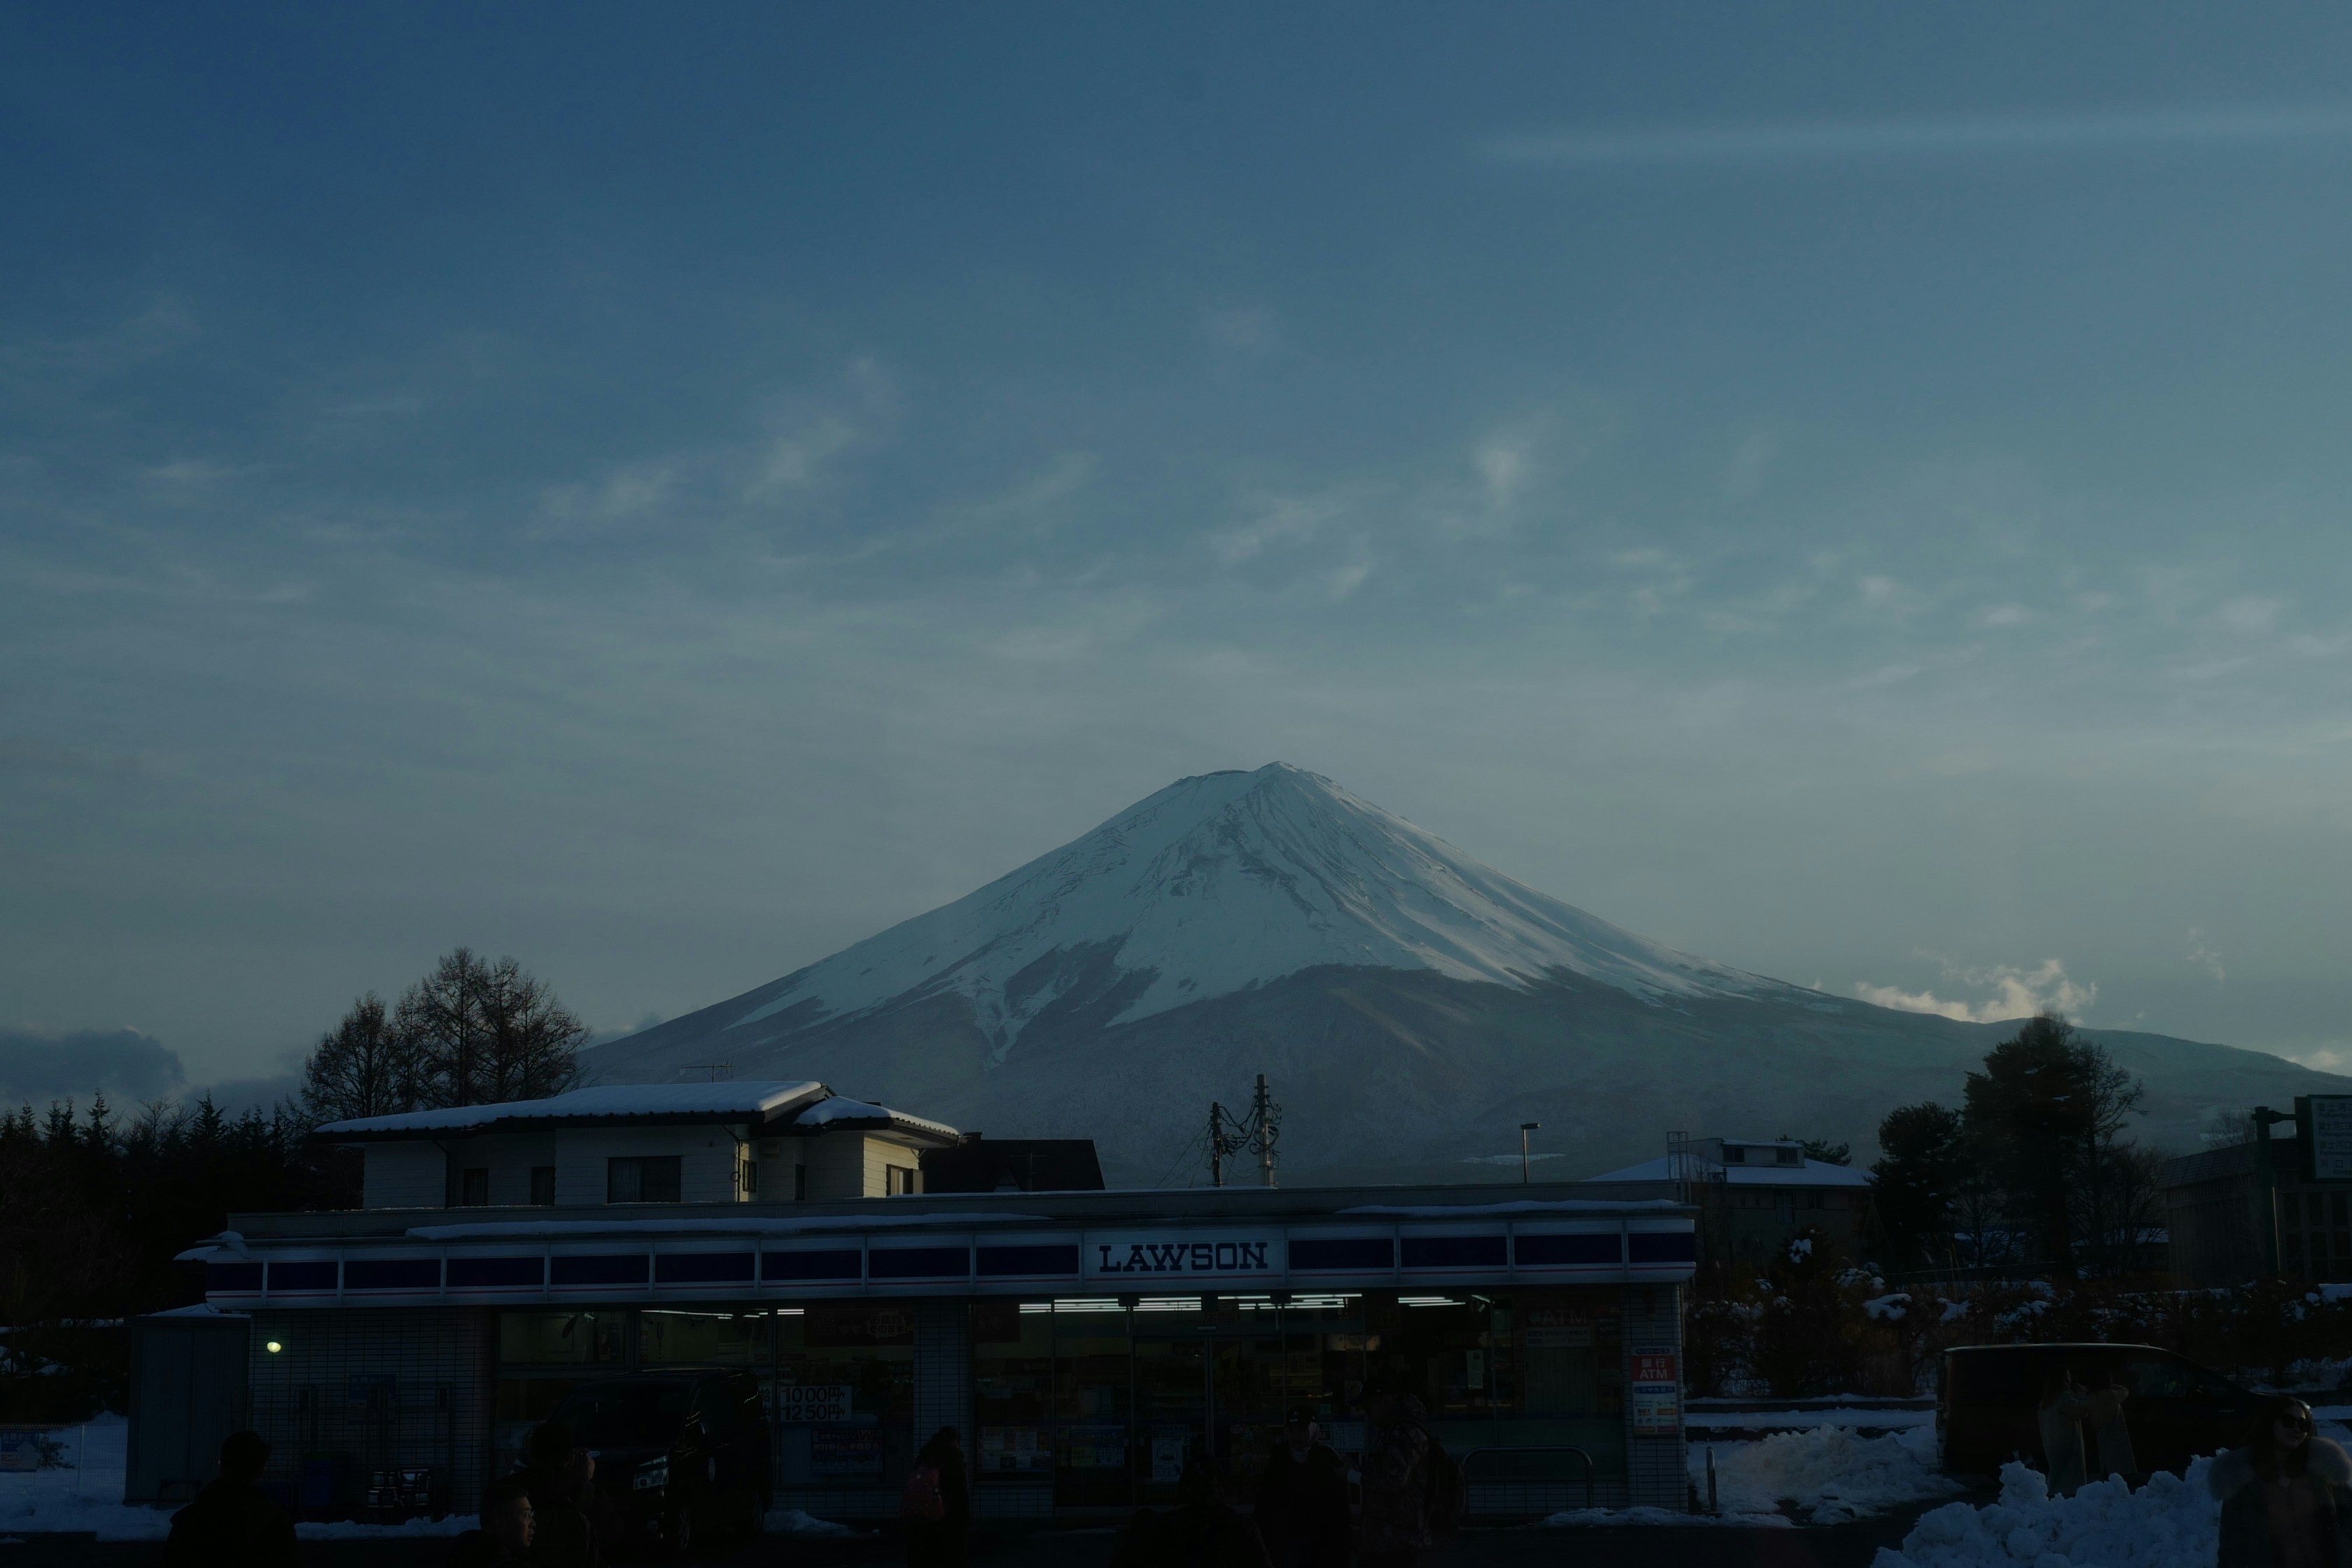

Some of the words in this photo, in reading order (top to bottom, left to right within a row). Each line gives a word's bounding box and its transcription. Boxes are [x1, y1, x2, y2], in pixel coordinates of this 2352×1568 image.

[1099, 1242, 1268, 1273] LAWSON
[1542, 1308, 1588, 1325] ATM
[1639, 1369, 1668, 1380] ATM
